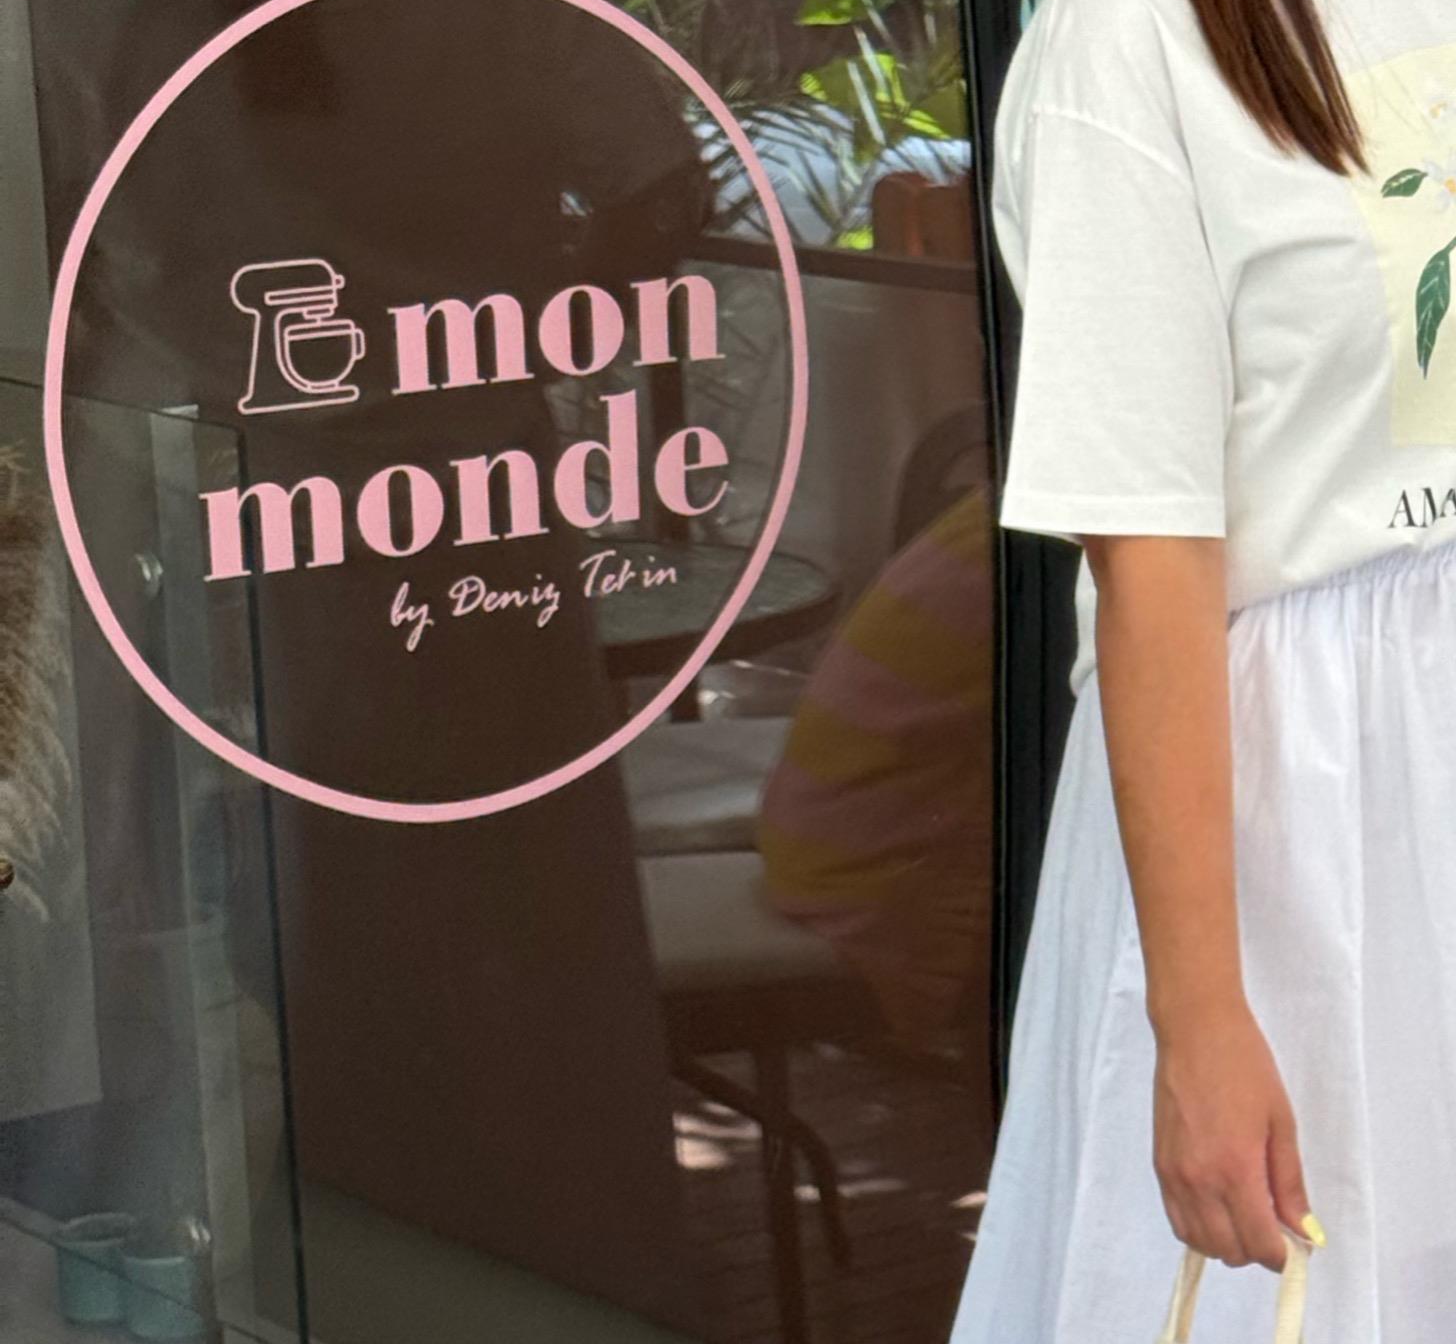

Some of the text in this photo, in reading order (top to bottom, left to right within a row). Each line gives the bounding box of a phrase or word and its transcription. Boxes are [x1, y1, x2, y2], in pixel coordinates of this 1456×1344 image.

[387, 275, 726, 396] mon
[198, 388, 729, 582] monde
[390, 581, 434, 652] by
